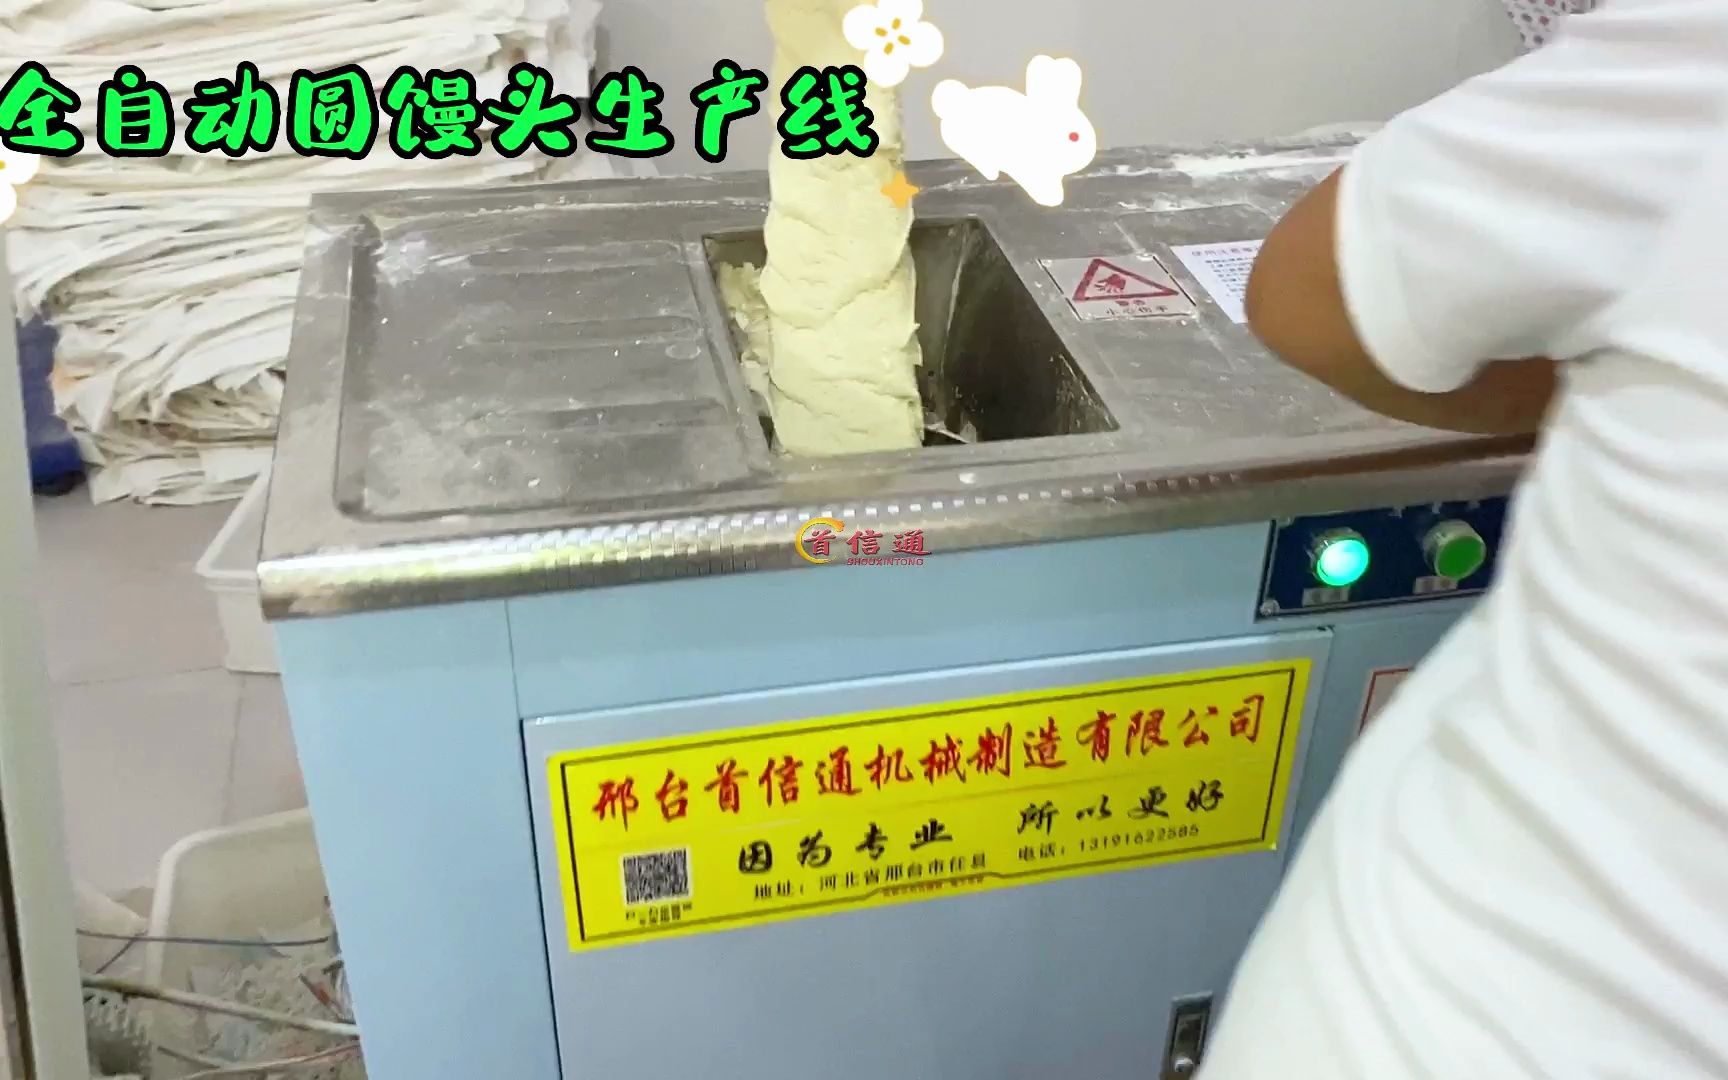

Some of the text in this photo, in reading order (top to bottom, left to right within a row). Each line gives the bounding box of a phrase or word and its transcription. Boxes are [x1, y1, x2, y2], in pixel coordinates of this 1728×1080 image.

[592, 695, 1265, 831] 邢台首信通机械制造有限公司
[738, 780, 1224, 873] 因为专业 所以更好
